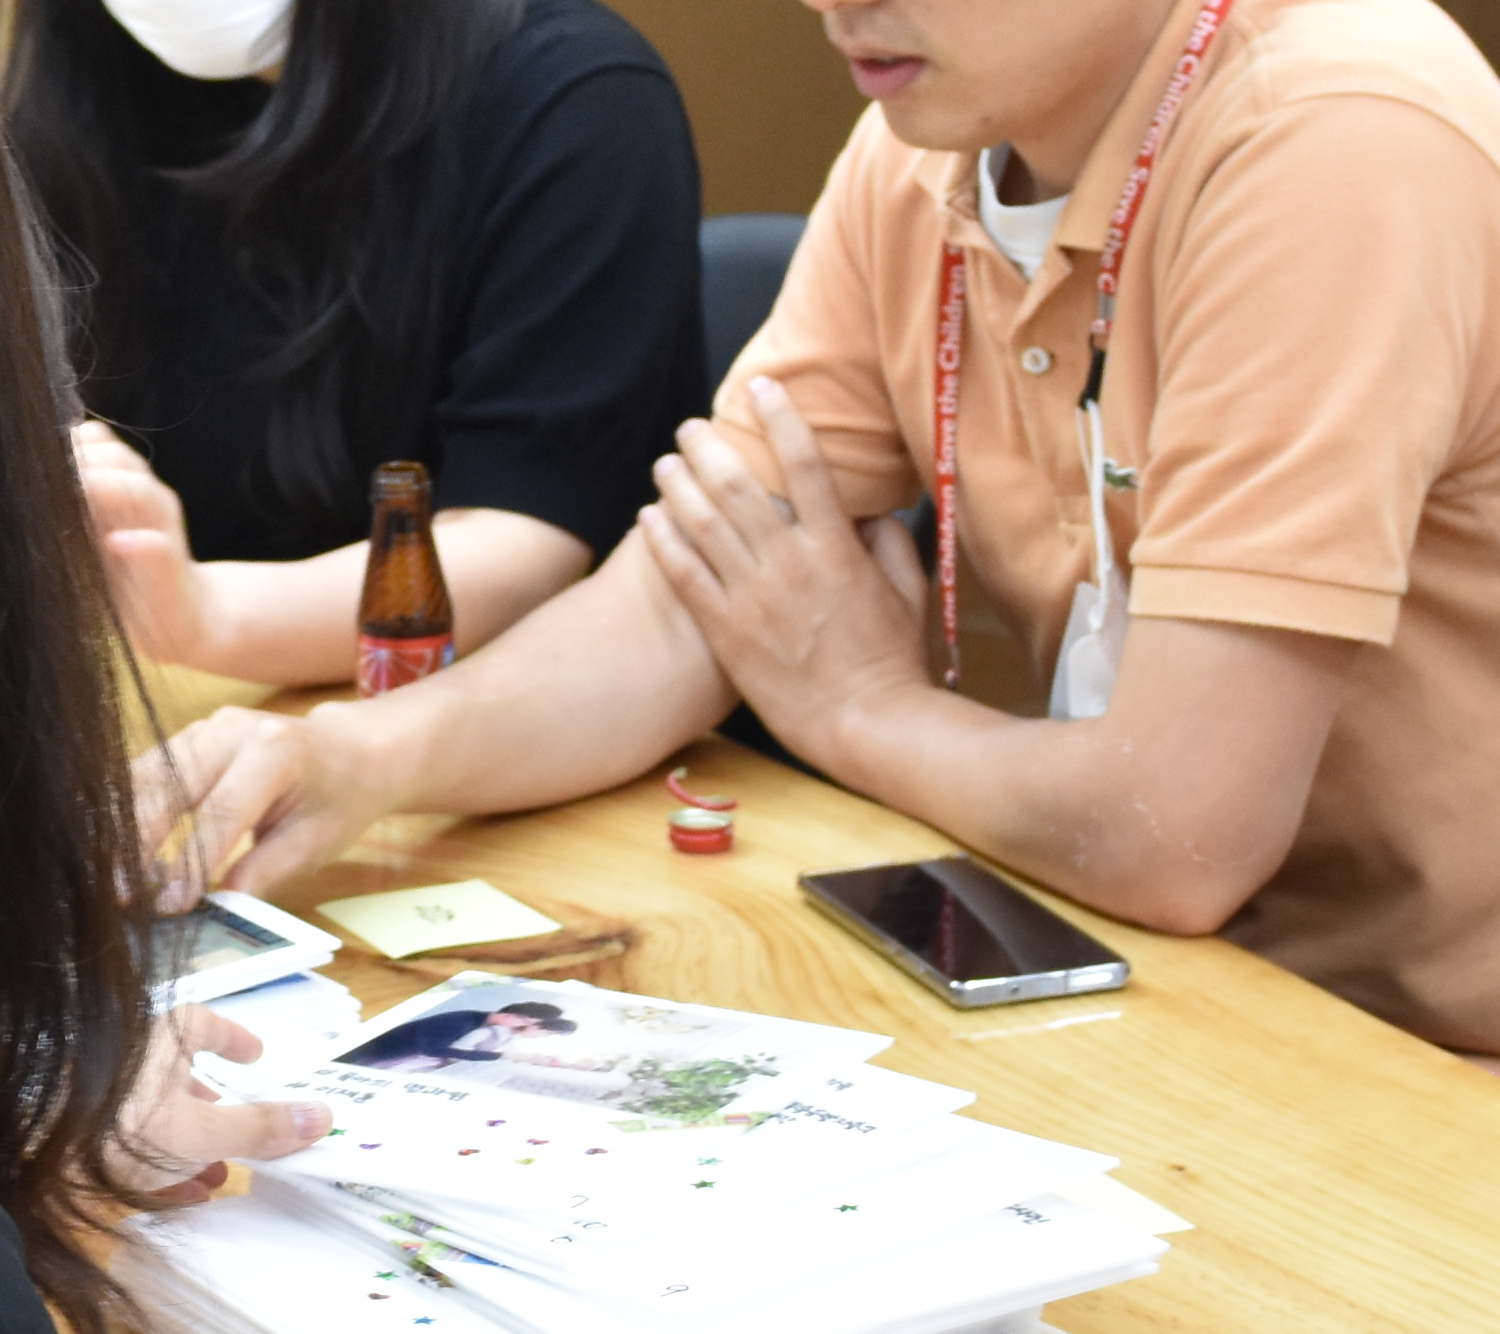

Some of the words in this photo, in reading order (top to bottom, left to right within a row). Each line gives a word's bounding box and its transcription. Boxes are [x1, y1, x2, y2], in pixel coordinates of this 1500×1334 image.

[1185, 9, 1219, 51] the
[1139, 53, 1199, 156] Children
[1113, 167, 1149, 224] Save
[1101, 227, 1124, 267] the
[937, 263, 965, 371] Children
[937, 372, 958, 415] the
[935, 418, 957, 475] Save
